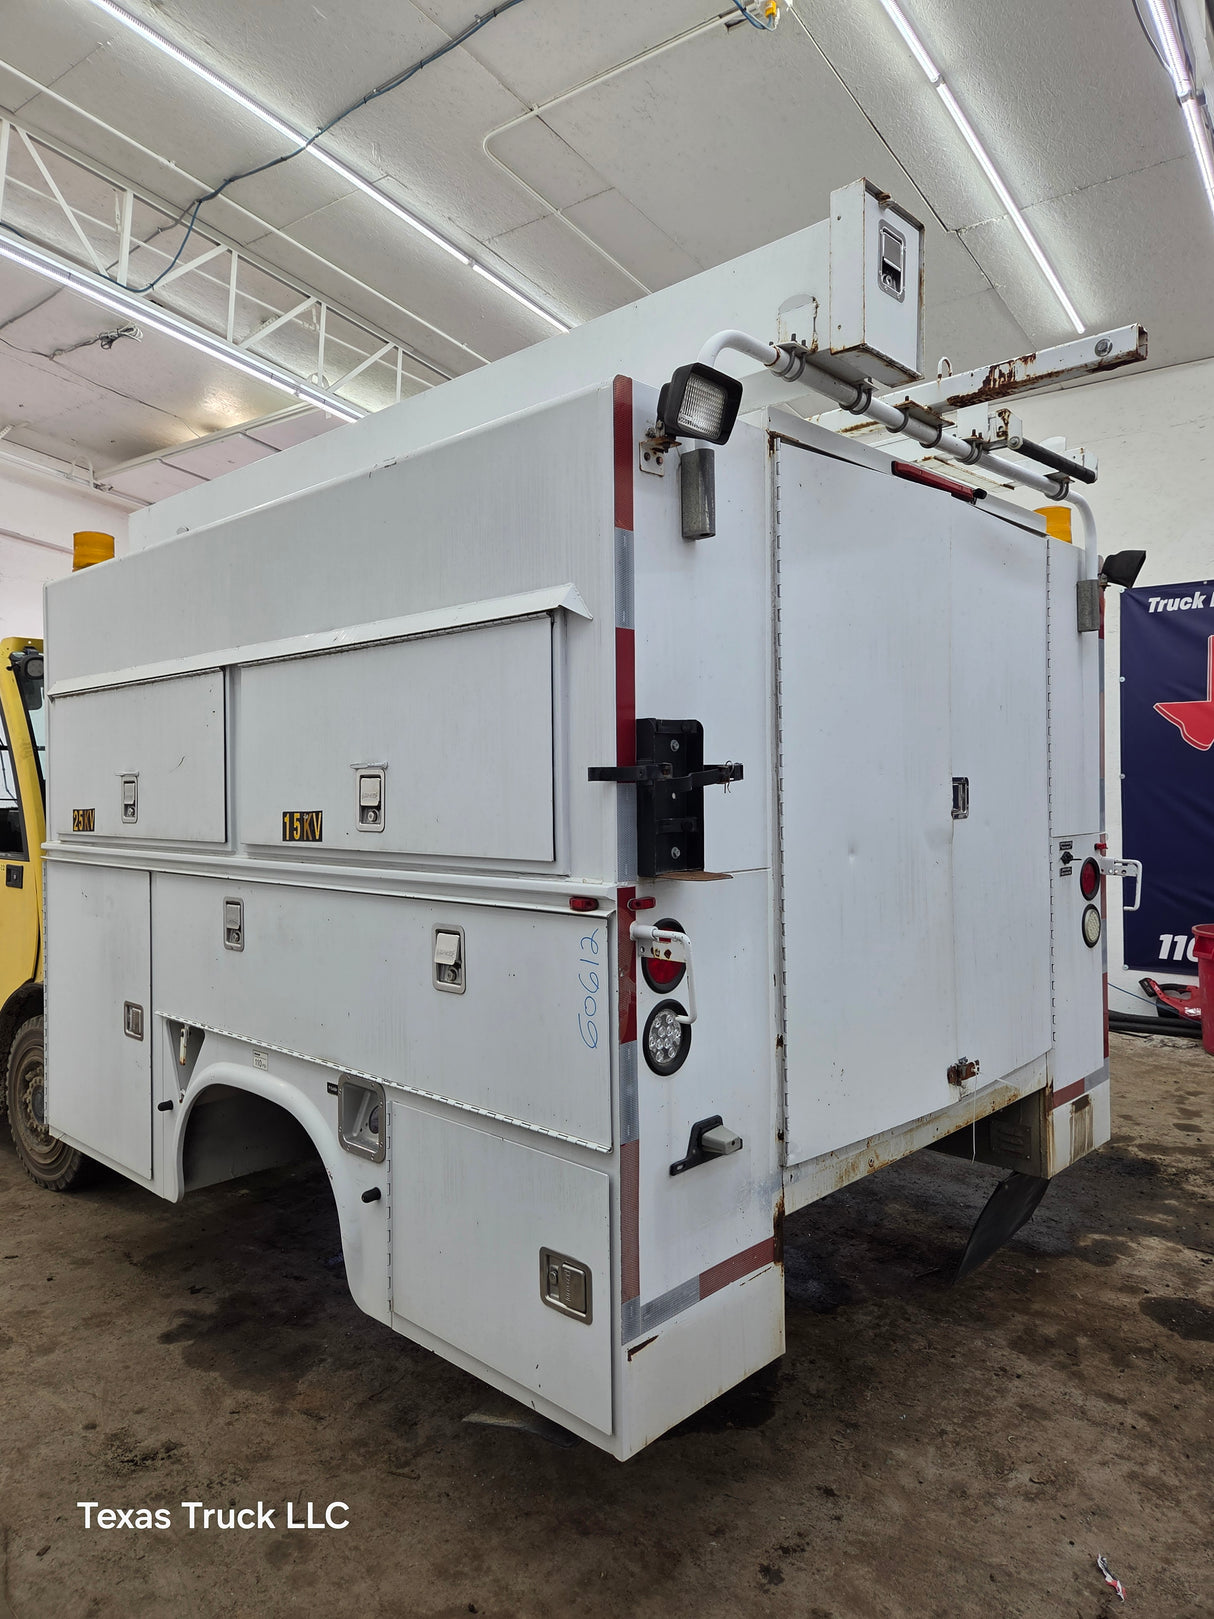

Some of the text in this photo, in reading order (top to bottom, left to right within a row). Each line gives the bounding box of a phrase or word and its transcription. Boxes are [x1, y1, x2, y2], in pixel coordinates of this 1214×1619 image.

[1148, 591, 1207, 613] Truck
[73, 809, 95, 832] 25KV
[284, 812, 322, 841] 15KV
[578, 928, 600, 1049] 60612
